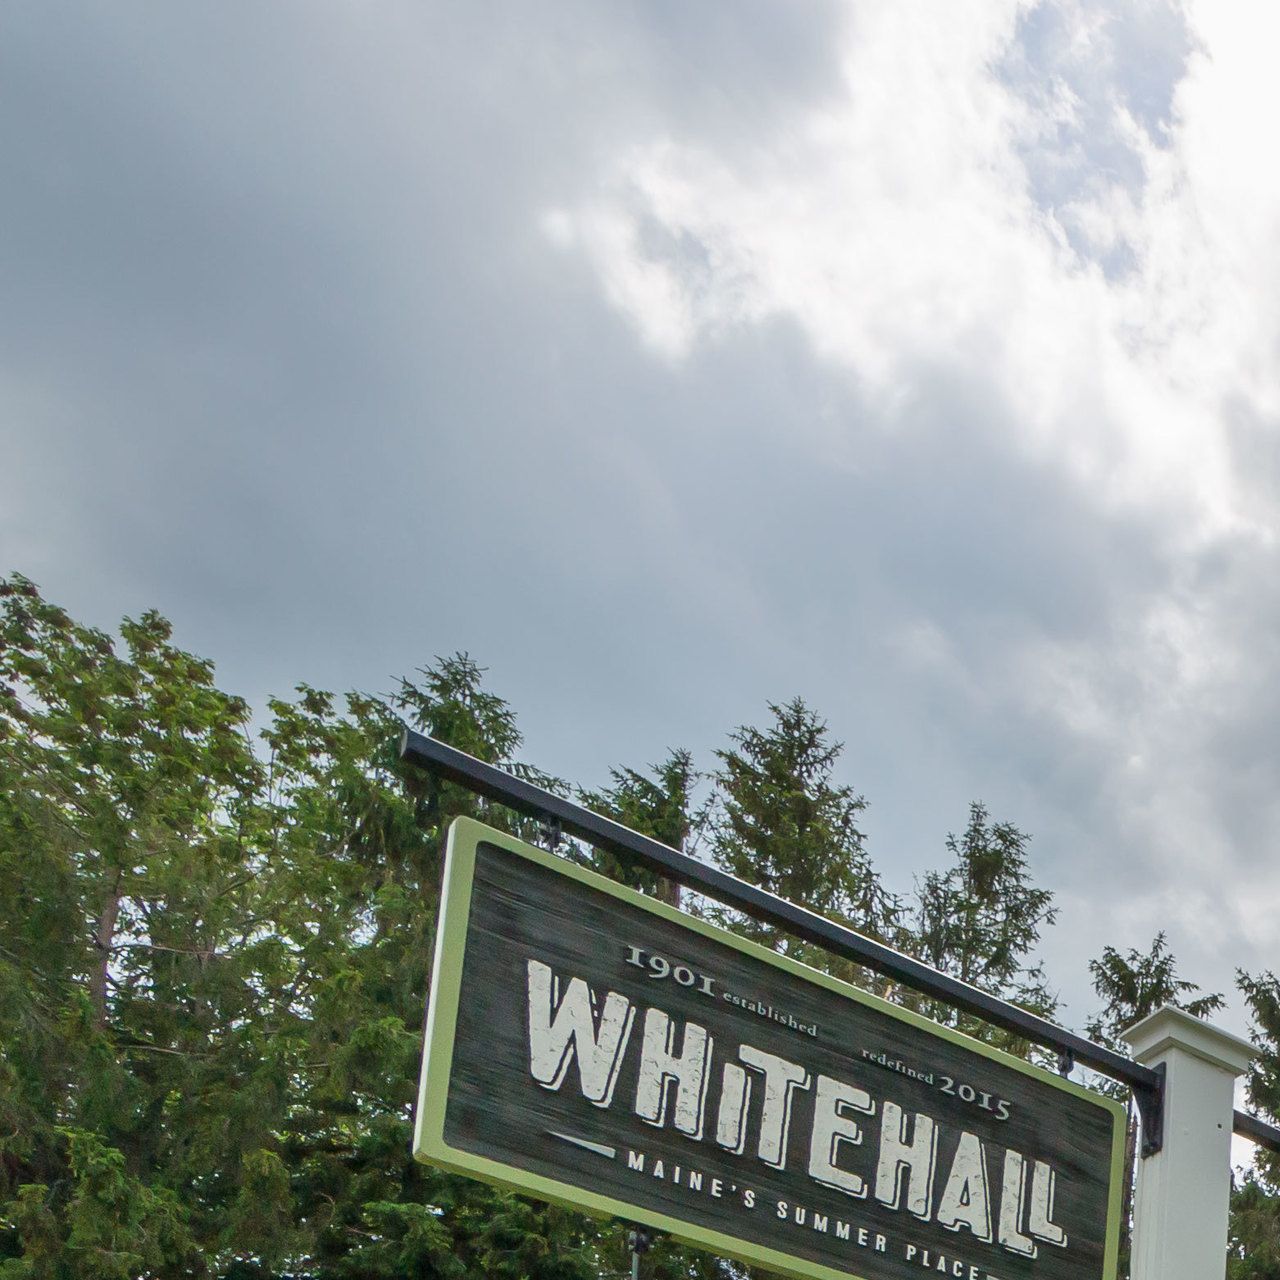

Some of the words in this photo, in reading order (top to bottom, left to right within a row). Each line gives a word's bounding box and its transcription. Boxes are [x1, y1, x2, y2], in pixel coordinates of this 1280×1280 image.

[527, 959, 1068, 1259] WHITEHALL
[626, 944, 717, 997] 1901
[722, 992, 820, 1037] established
[862, 1050, 934, 1086] redefined
[939, 1076, 1011, 1121] 2015
[627, 1150, 756, 1209] MAINE'S
[776, 1201, 887, 1253] SUMMER
